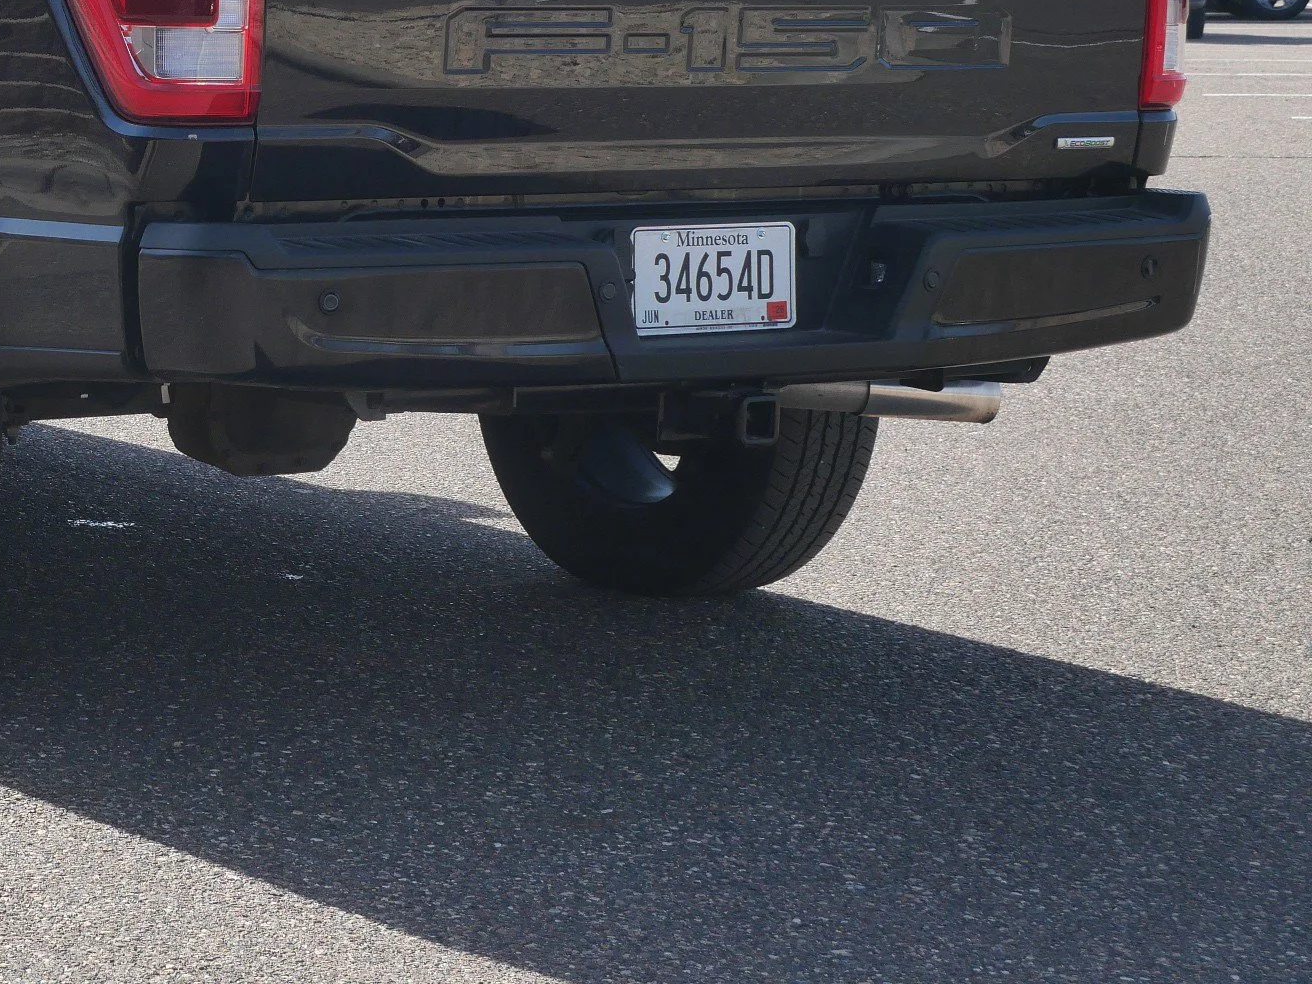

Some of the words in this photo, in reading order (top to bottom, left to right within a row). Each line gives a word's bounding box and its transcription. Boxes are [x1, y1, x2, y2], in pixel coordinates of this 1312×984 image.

[443, 4, 1012, 75] F-150
[676, 230, 749, 248] Minnesota
[654, 249, 774, 304] 34654D
[642, 310, 660, 324] JUN
[694, 309, 734, 321] DEALER
